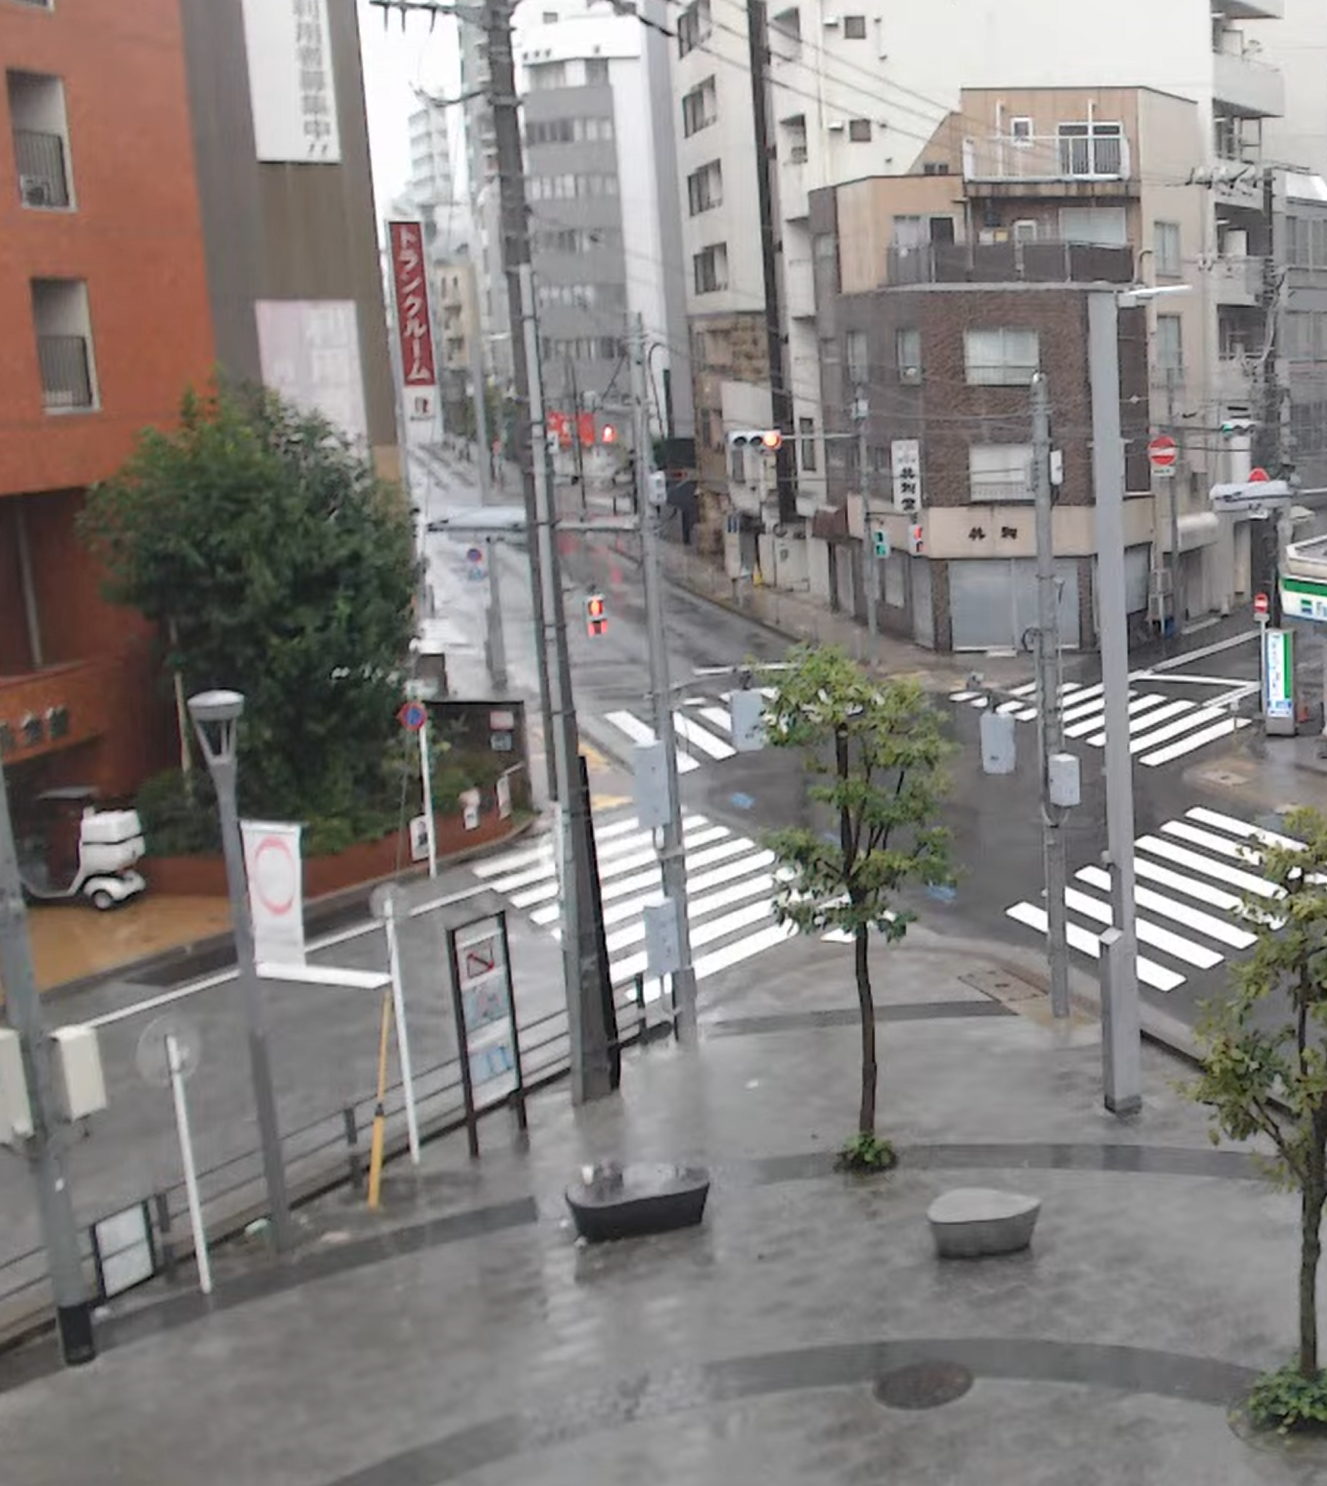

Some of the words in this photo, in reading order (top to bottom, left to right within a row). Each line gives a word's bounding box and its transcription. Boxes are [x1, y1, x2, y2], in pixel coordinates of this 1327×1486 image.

[399, 226, 432, 381] トランクルーム
